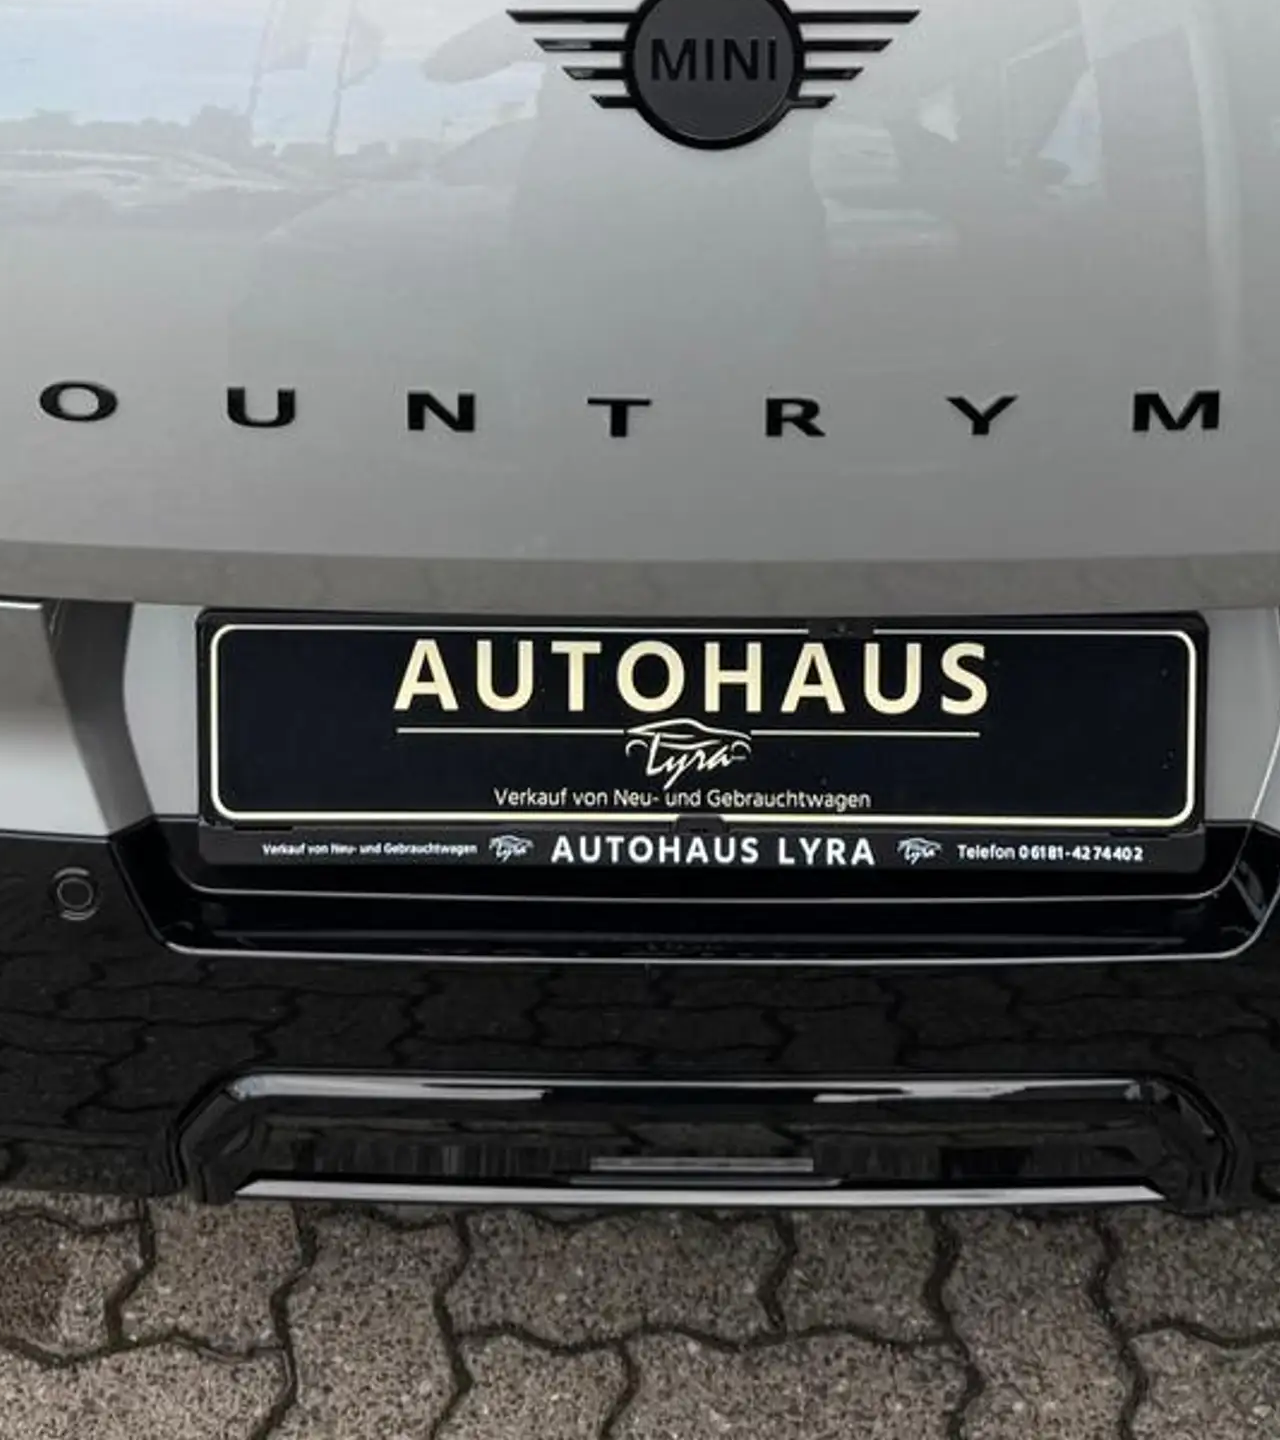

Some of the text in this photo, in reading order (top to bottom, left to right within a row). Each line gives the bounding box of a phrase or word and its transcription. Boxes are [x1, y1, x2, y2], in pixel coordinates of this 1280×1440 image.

[650, 38, 778, 82] MINI
[393, 638, 989, 715] AUTOHAUS
[646, 732, 733, 790] Lyra
[493, 787, 872, 812] Verkauf von Neu- und Gebrauchtwagen
[262, 842, 478, 858] Verkauf von Neu- und Gebrauchtwagen
[550, 835, 875, 865] AUTOHAUS LYRA
[957, 843, 1144, 862] Telefon 06181-4274402
